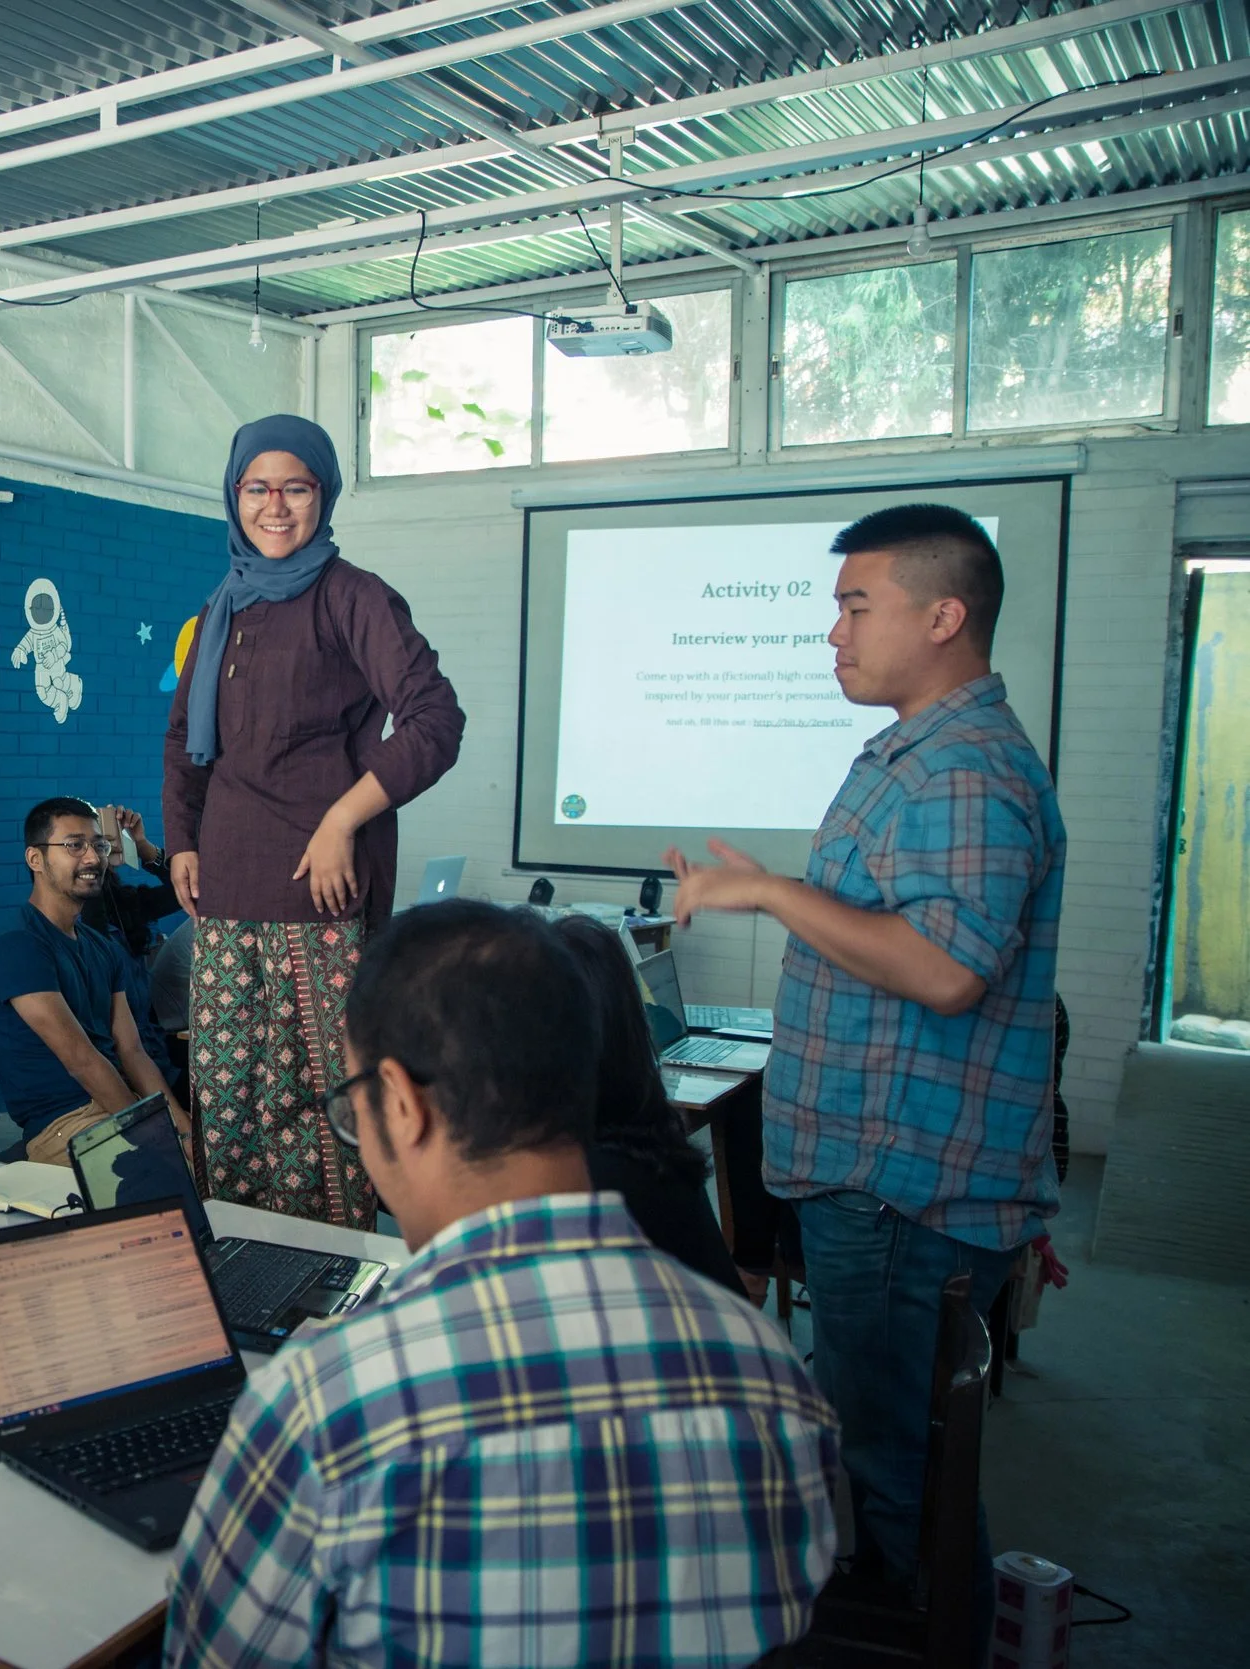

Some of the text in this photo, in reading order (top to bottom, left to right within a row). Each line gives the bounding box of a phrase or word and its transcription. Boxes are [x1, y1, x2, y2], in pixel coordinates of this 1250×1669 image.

[701, 580, 812, 602] Activity 02
[672, 631, 830, 649] Interview your part
[636, 671, 668, 681] Come
[670, 673, 684, 683] up
[687, 671, 710, 681] with
[722, 671, 775, 683] (fictional)
[777, 670, 801, 683] high
[644, 690, 688, 702] inspired
[690, 690, 704, 702] by
[706, 692, 731, 702] your
[734, 690, 783, 702] partner's
